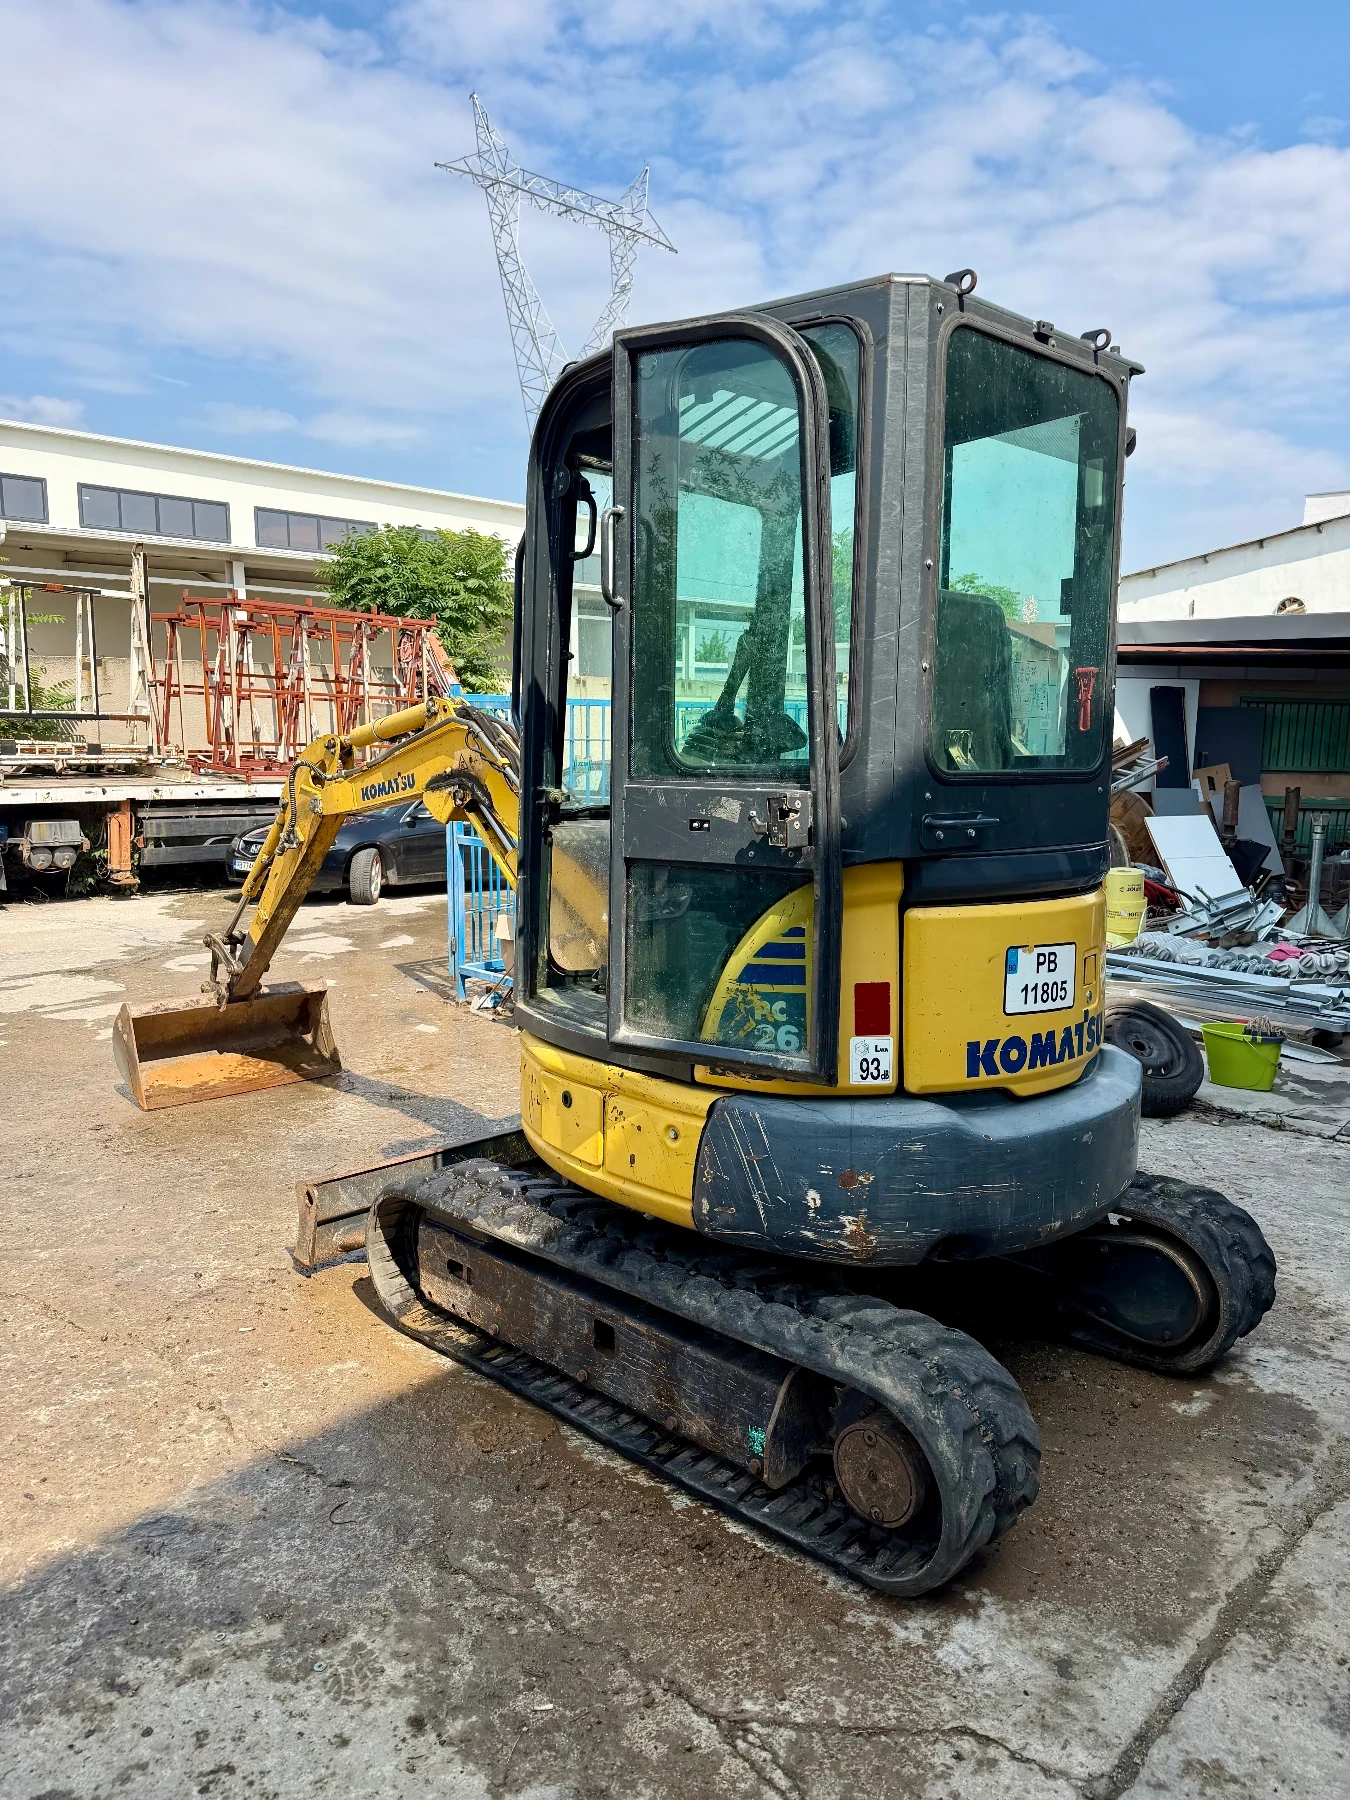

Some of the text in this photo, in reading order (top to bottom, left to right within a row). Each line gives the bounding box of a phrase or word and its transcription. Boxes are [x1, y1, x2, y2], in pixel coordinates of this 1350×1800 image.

[361, 771, 415, 801] KOMATSU
[1008, 964, 1017, 972] BG
[1036, 951, 1058, 974] PB
[1020, 980, 1068, 1005] 11805
[754, 1023, 800, 1051] 26
[966, 1008, 1104, 1079] KOMATSU
[859, 1057, 881, 1081] 93
